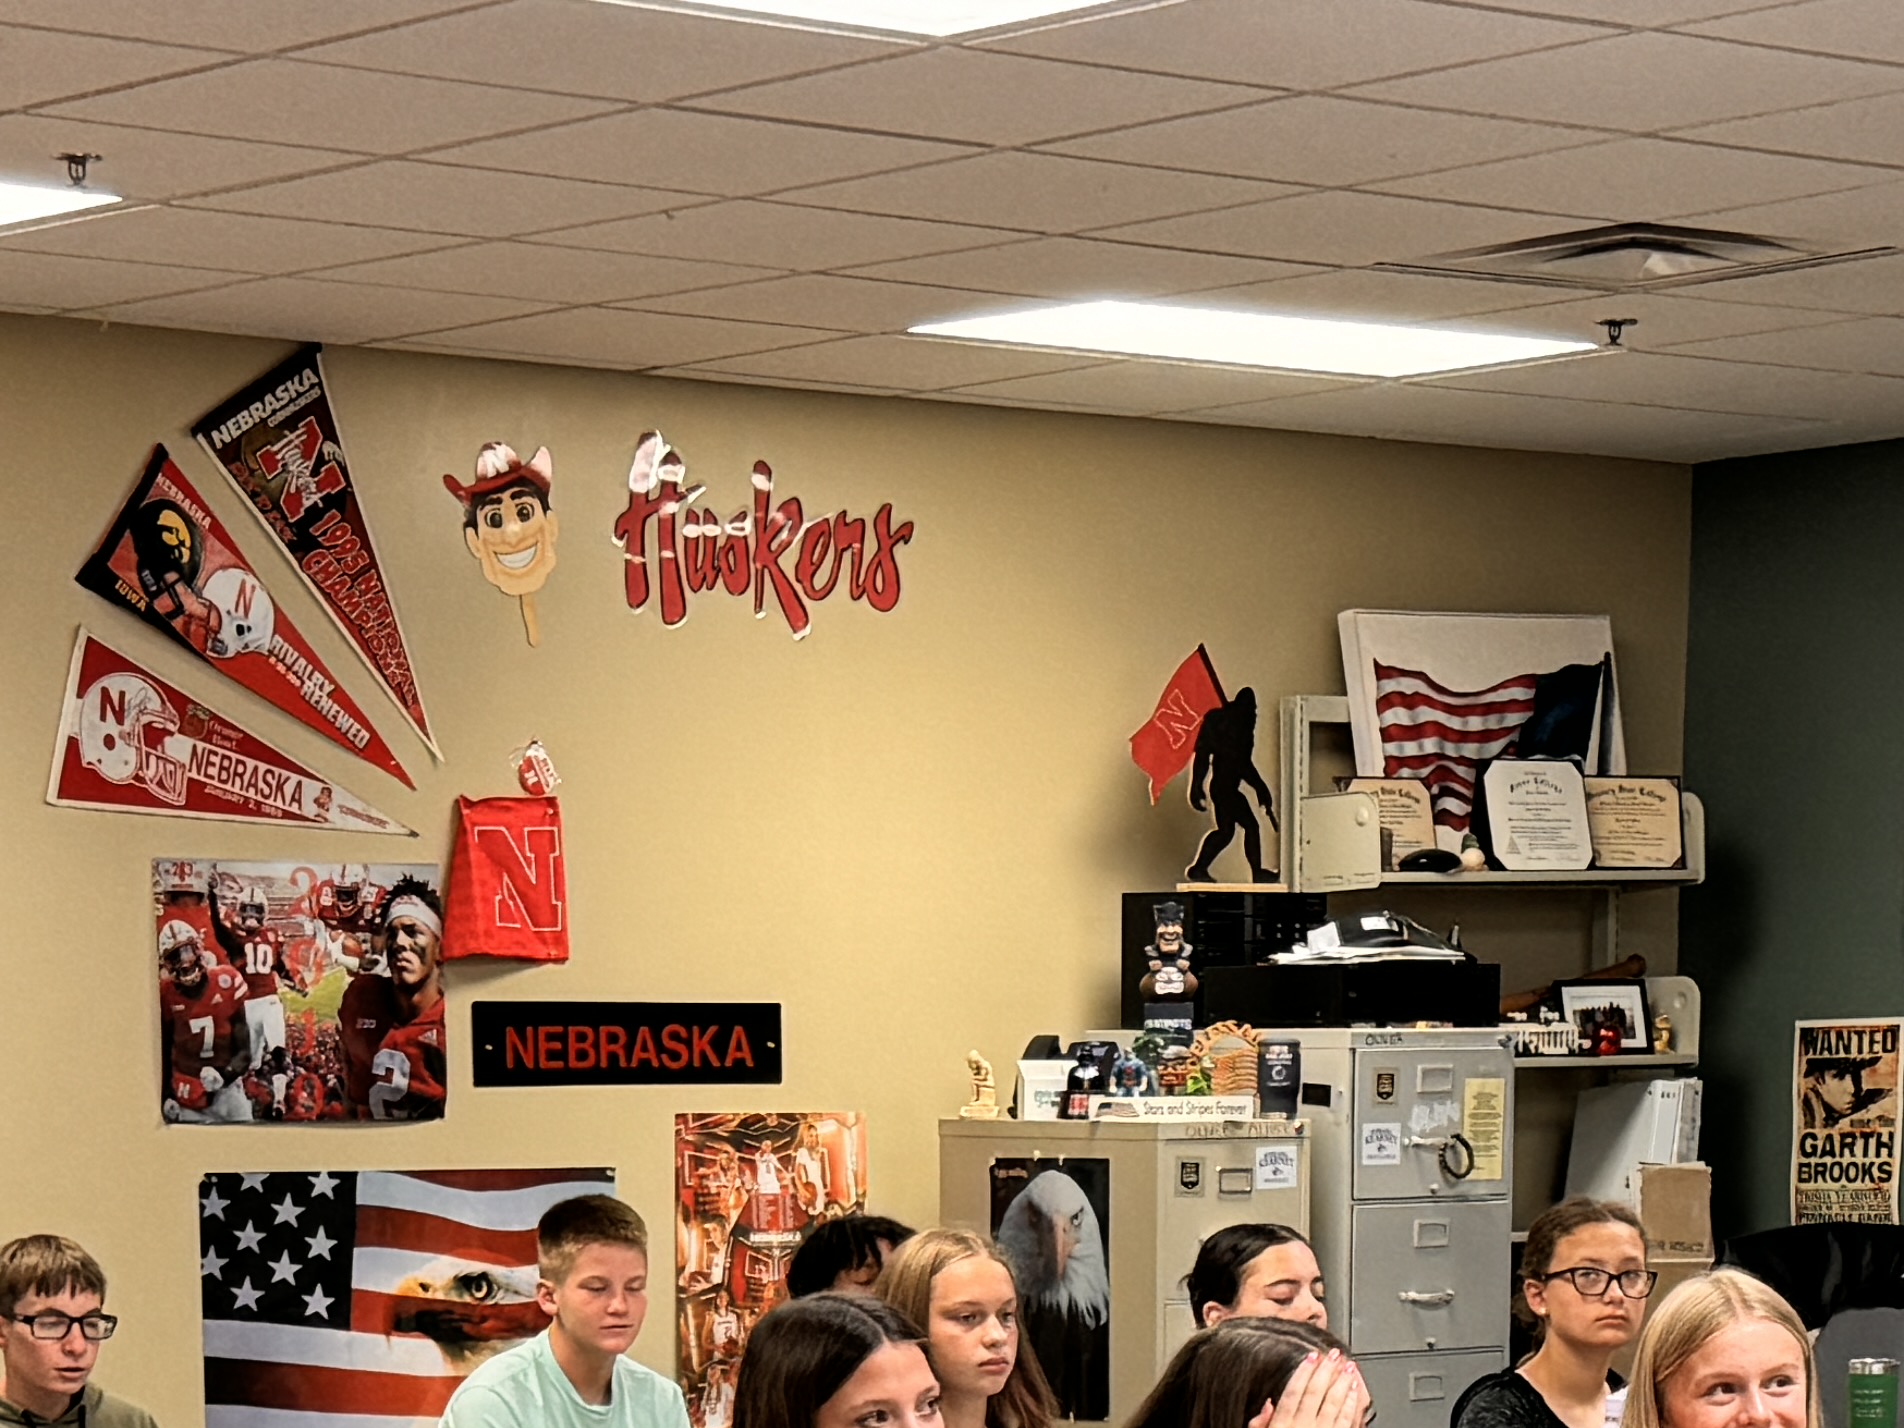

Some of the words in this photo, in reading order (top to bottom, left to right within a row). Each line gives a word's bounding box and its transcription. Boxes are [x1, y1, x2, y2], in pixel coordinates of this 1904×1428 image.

[210, 368, 319, 449] NEBRASKA
[156, 472, 211, 529] NEBRASKA
[309, 509, 370, 573] 1995
[612, 429, 914, 641] Huskers
[115, 579, 149, 612] IOWA
[234, 578, 256, 619] N
[270, 634, 335, 697] RIVALRY
[99, 686, 126, 726] N
[302, 680, 370, 750] RENEWED
[1153, 688, 1202, 749] N
[189, 744, 304, 811] NEBRASKA
[474, 827, 563, 931] N
[245, 942, 274, 975] 10
[189, 1016, 215, 1059] 7
[504, 1024, 754, 1072] NEBRASKA
[1802, 1028, 1896, 1057] WANTED
[1167, 1101, 1183, 1116] and
[1185, 1101, 1214, 1118] Stripes
[1800, 1131, 1894, 1159] GARTH
[1798, 1161, 1892, 1184] BROOKS
